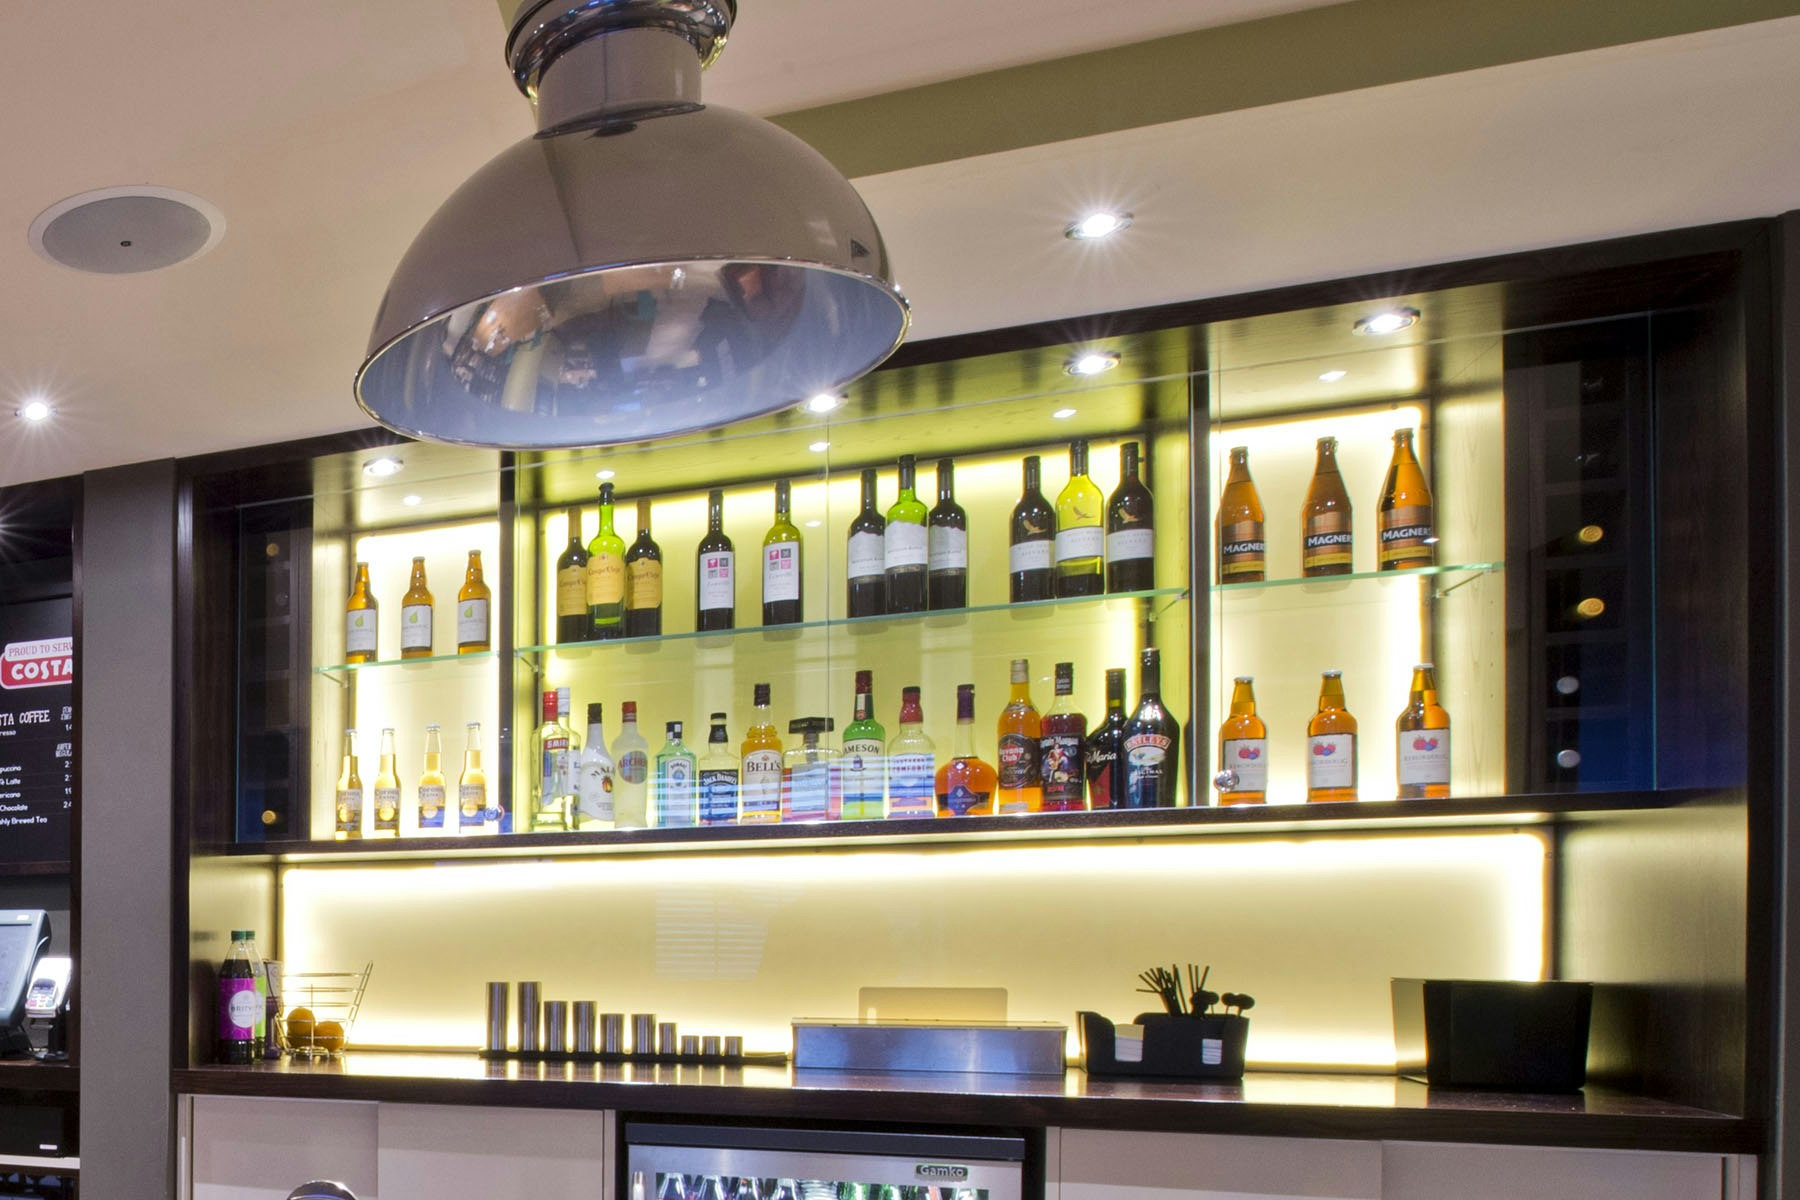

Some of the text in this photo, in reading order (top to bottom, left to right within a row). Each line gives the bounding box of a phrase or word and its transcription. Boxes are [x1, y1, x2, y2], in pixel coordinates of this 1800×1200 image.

[1383, 526, 1433, 540] MAGNERS
[9, 646, 38, 657] PROUD
[40, 644, 50, 654] TO
[11, 658, 72, 680] COSTA
[19, 710, 50, 724] COFFEE
[843, 743, 881, 753] AMESON
[1127, 734, 1167, 749] BAILEYS
[1093, 751, 1117, 762] Maria
[0, 804, 28, 812] Chocolate
[11, 816, 35, 825] Brewed
[36, 815, 48, 823] Tea
[920, 1164, 964, 1177] Gamko
